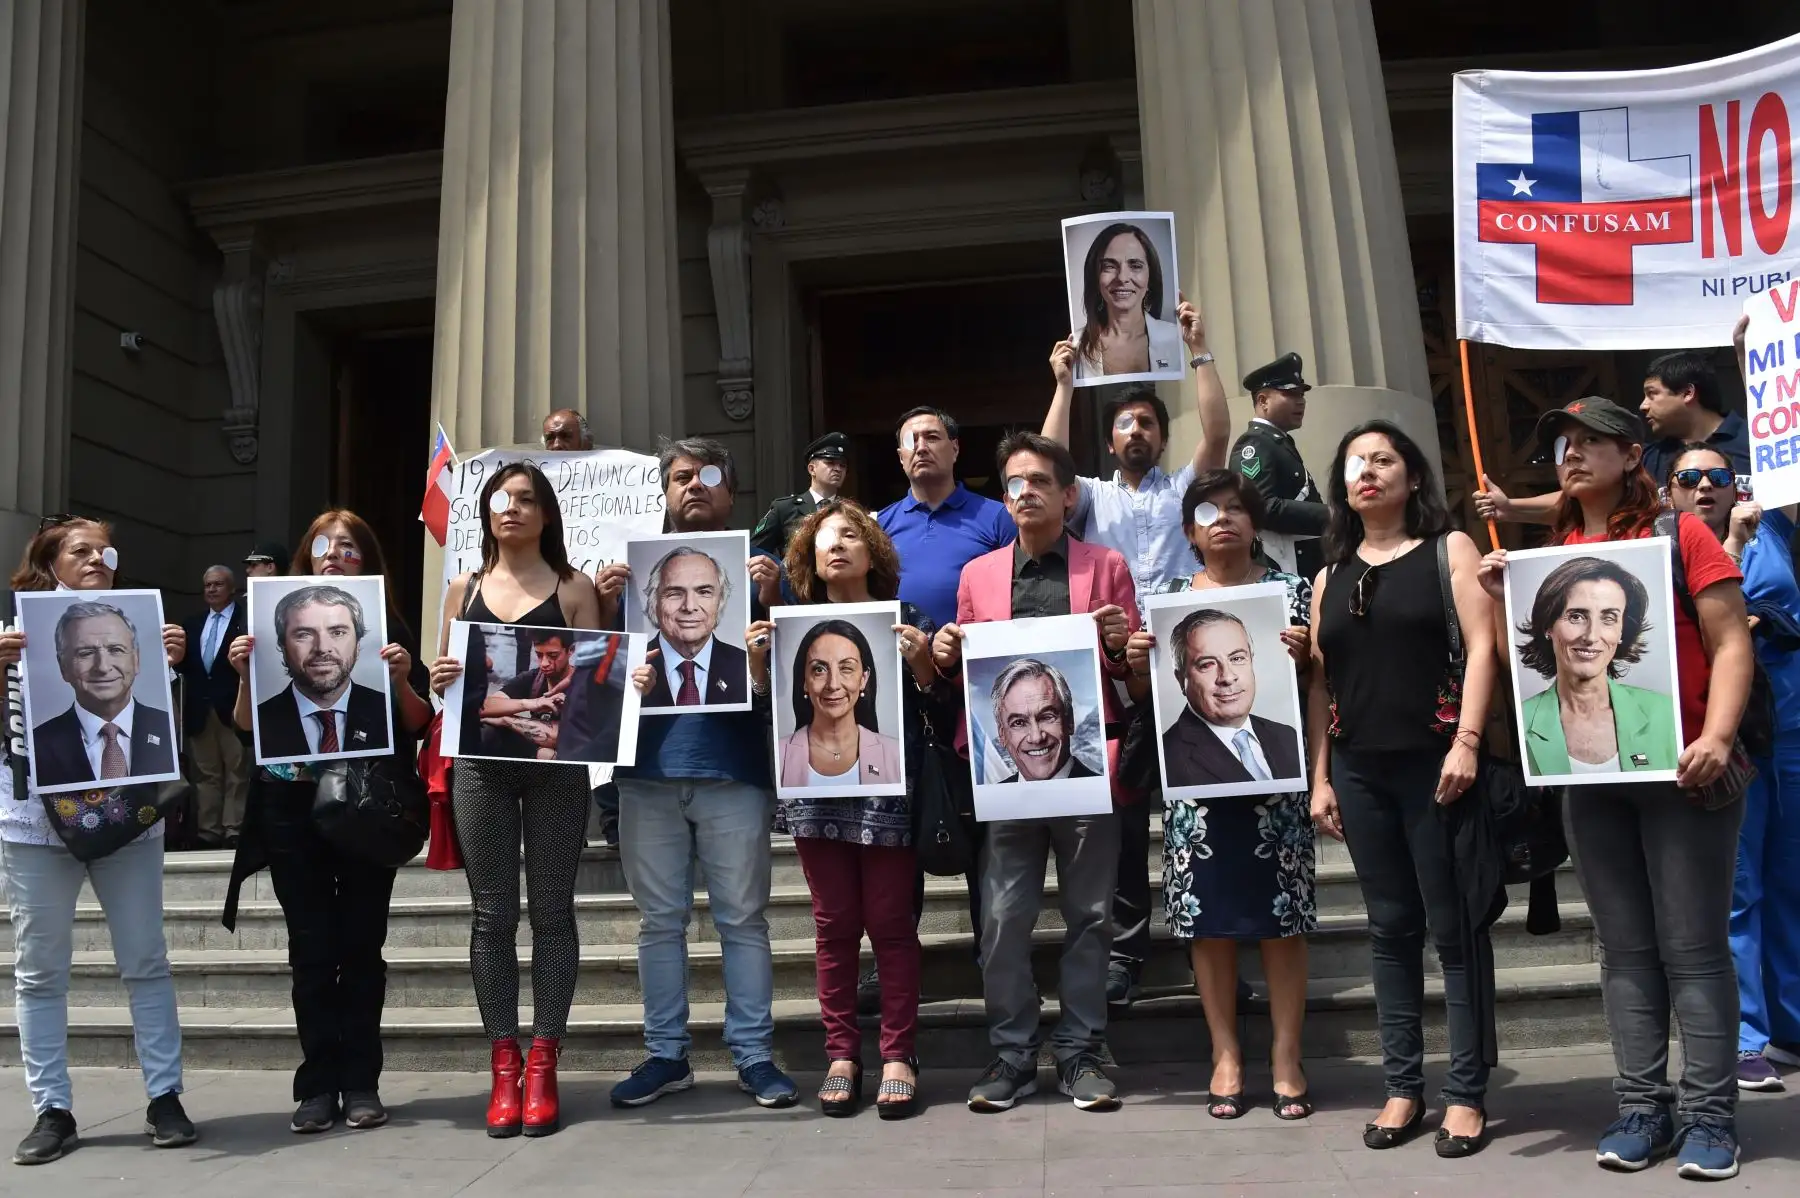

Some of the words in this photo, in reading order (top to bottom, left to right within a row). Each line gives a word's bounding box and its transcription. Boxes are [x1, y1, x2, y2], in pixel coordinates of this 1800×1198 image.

[1698, 92, 1793, 259] NO
[1495, 211, 1672, 234] CONFUSAM
[1702, 278, 1725, 297] NI
[1769, 280, 1800, 323] V
[1748, 339, 1785, 376] MI
[1748, 380, 1767, 409] Y
[458, 459, 485, 495] 19
[558, 460, 661, 493] DENUNCIO
